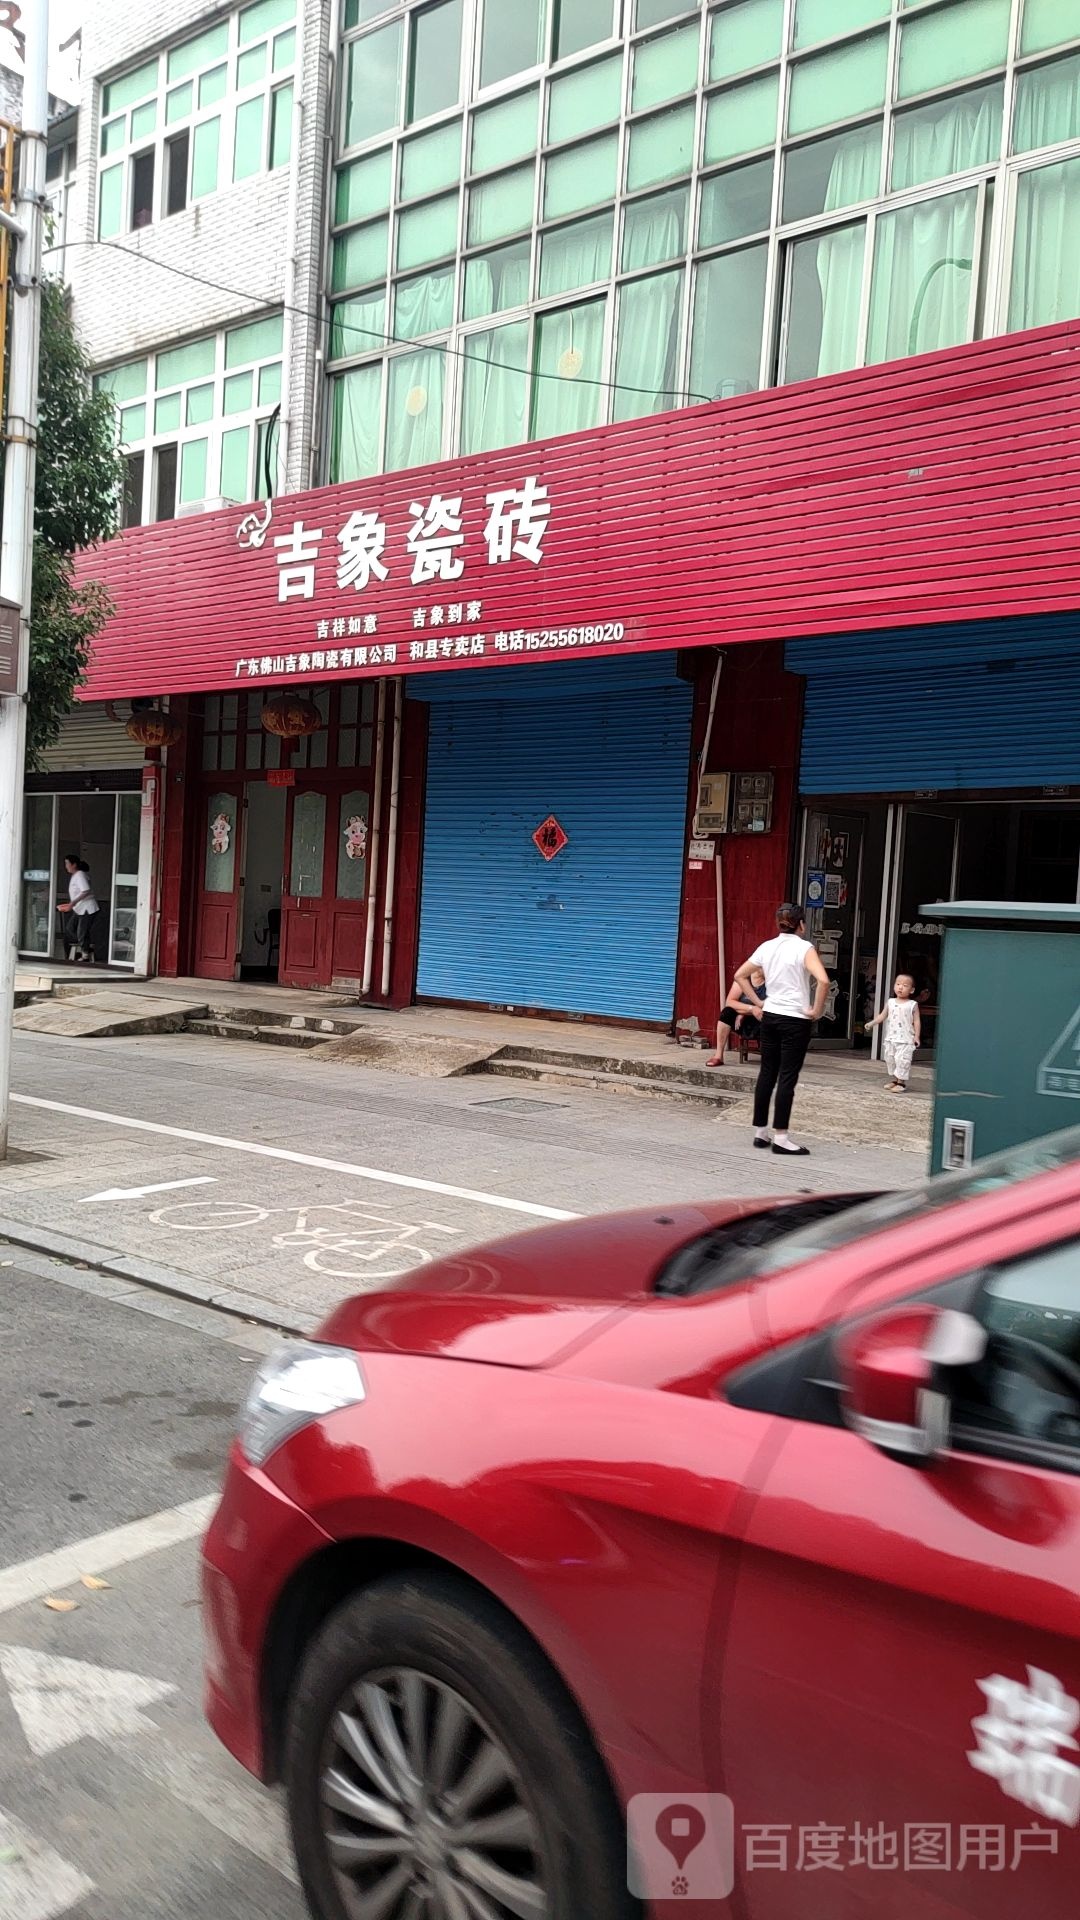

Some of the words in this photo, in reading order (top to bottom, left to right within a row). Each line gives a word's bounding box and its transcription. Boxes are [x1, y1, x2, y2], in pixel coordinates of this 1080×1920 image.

[274, 477, 551, 602] 吉象瓷砖
[316, 614, 378, 639] 吉祥如意
[412, 600, 482, 628] 吉象到家
[235, 644, 397, 677] 广东佛山吉象陶瓷有限公司
[409, 634, 486, 661] 和县专卖店
[494, 622, 624, 652] 电话15255618020
